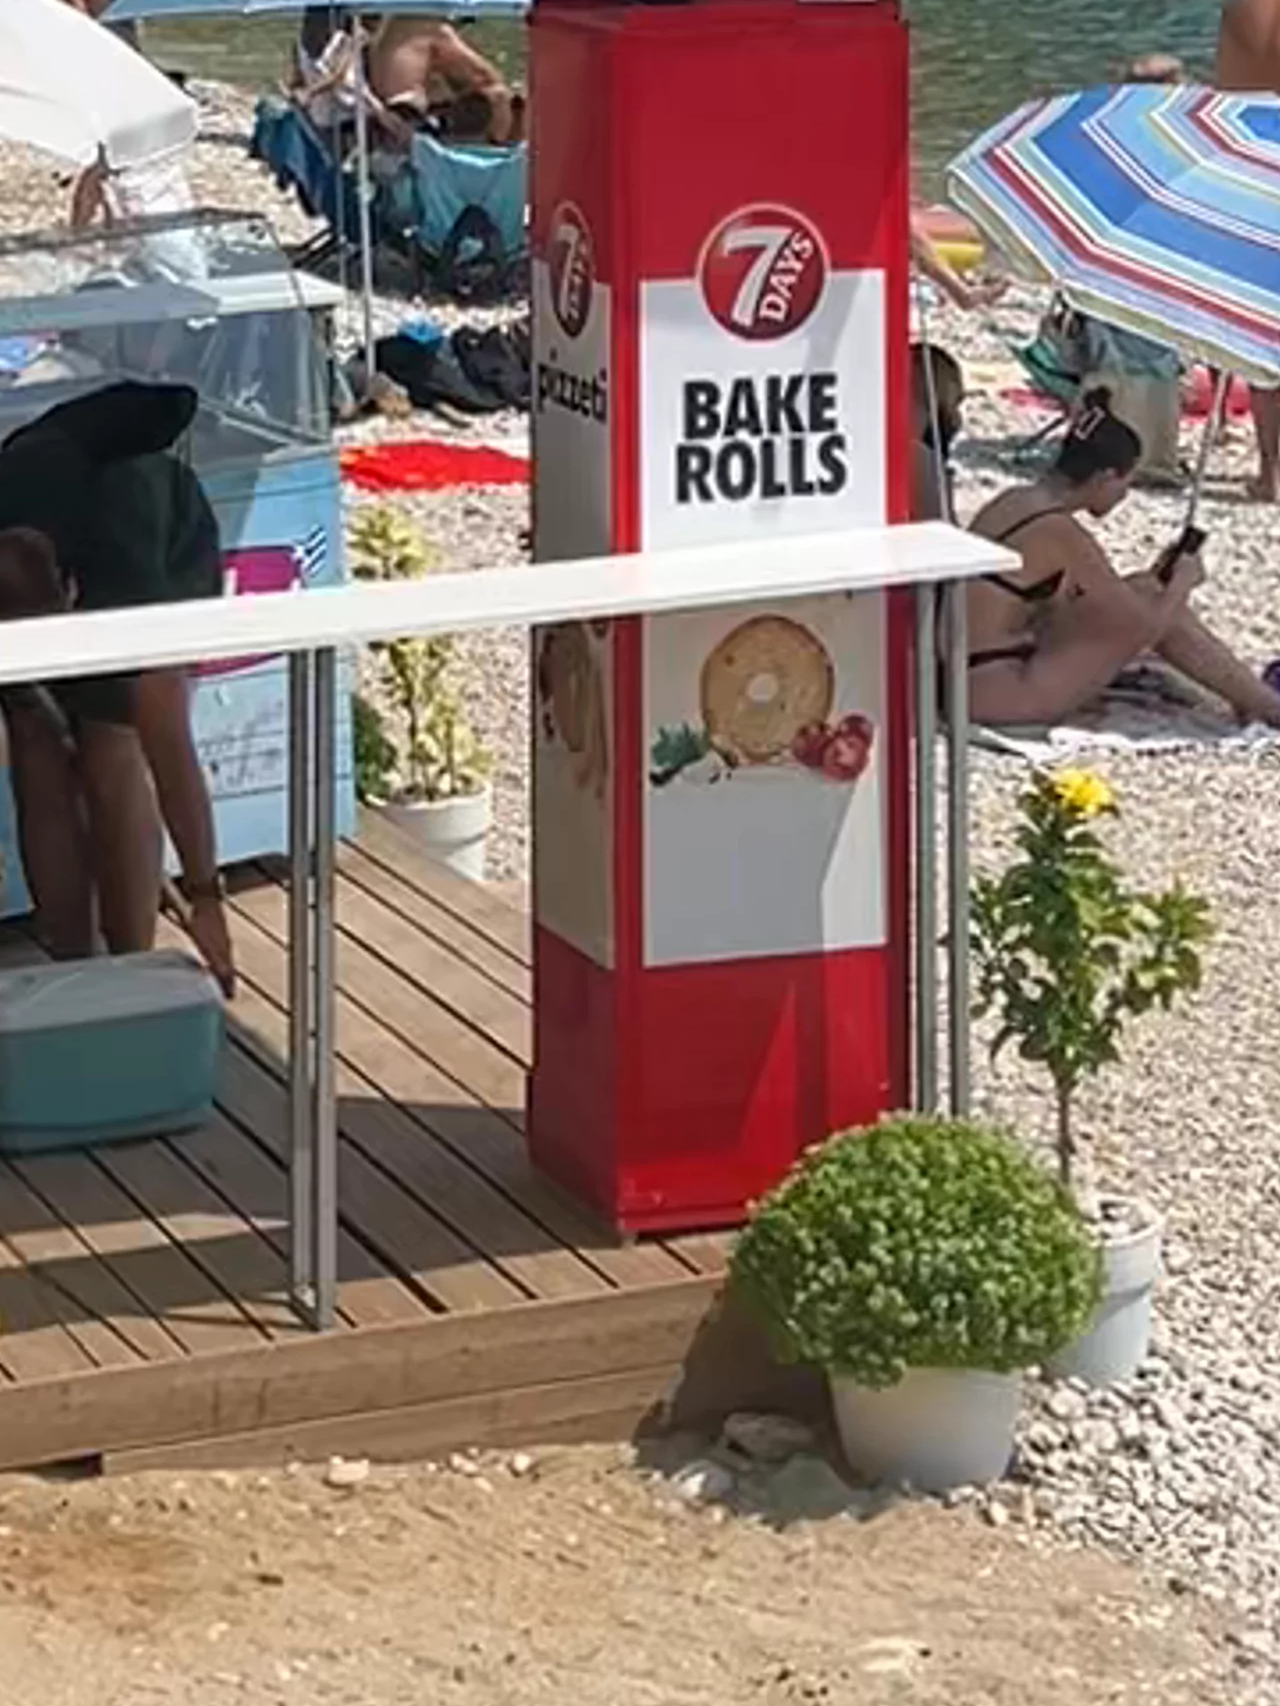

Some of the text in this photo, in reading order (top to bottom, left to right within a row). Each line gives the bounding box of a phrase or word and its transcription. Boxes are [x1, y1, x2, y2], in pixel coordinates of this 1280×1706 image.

[724, 226, 813, 327] 7 DAYS
[684, 372, 838, 440] BAKE
[676, 434, 847, 504] ROLLS
